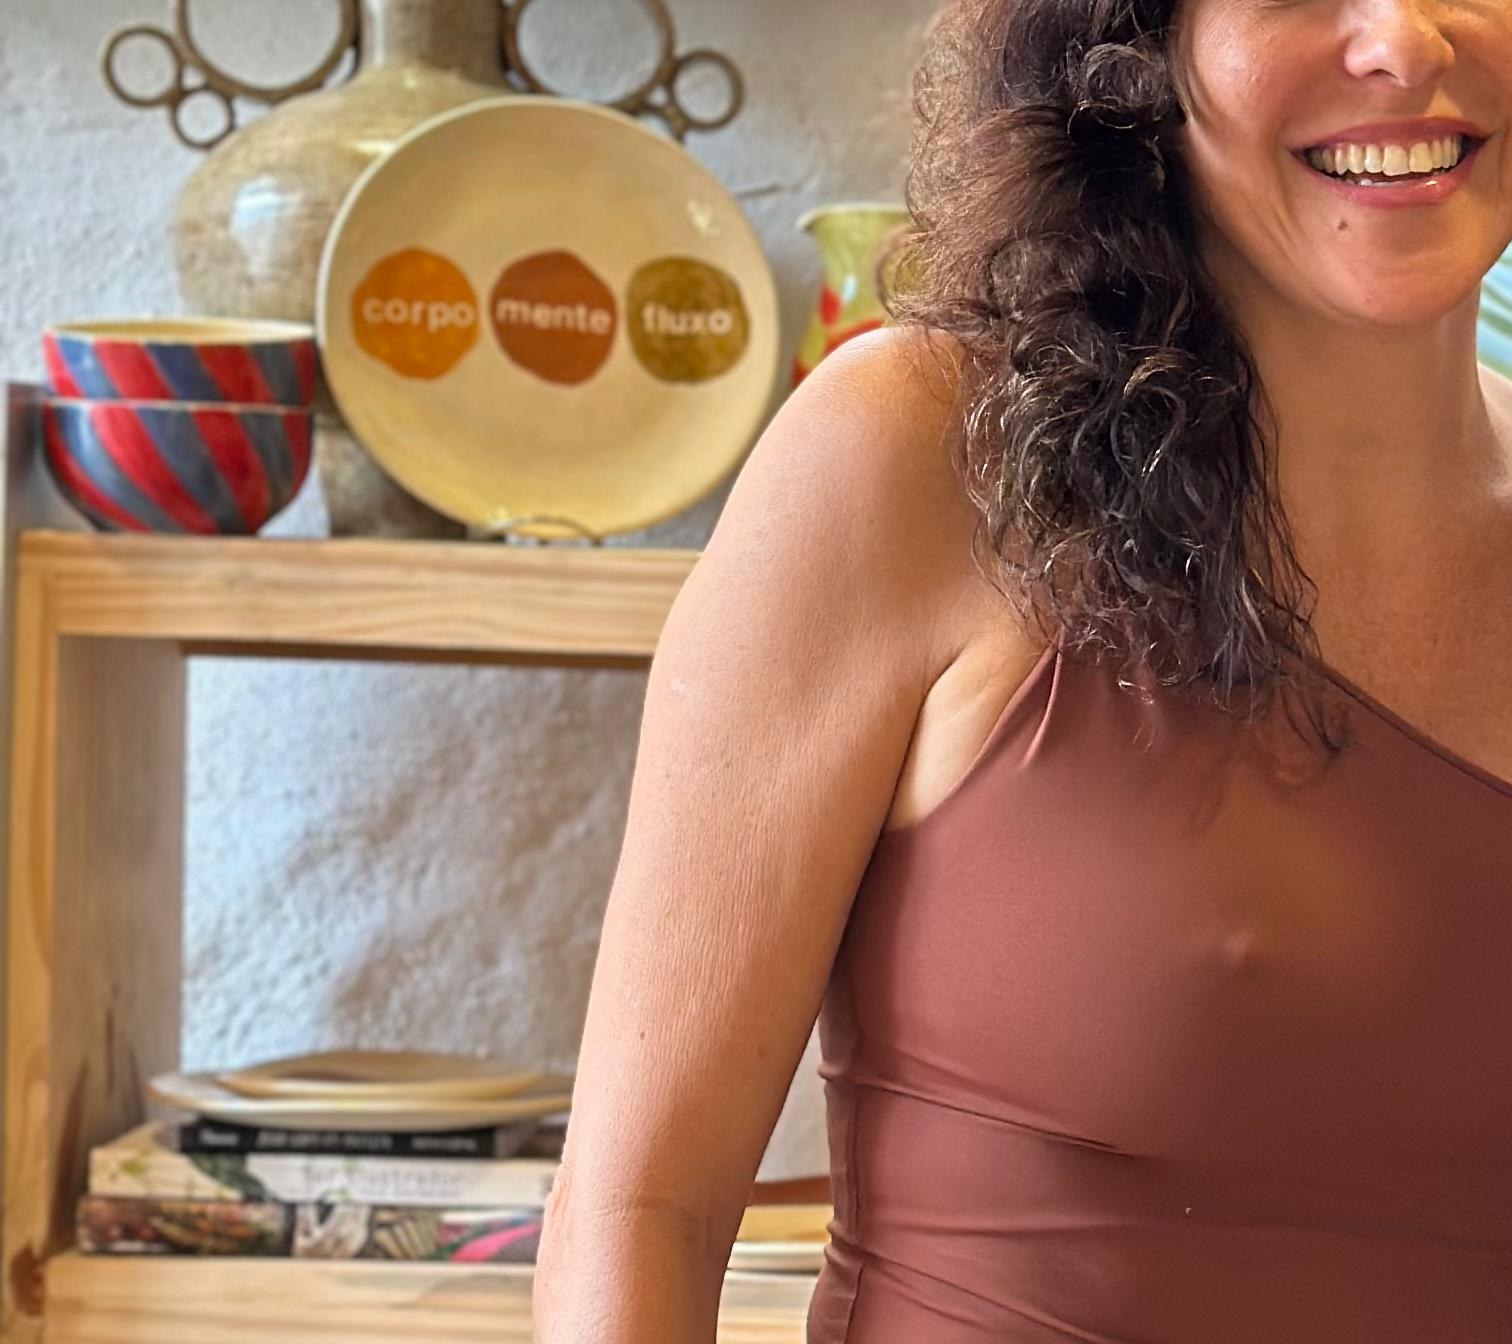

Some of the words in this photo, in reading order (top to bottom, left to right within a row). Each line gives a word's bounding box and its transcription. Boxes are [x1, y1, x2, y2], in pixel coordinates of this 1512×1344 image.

[362, 297, 474, 332] corpo
[496, 298, 612, 335] mente
[641, 302, 733, 337] fluxo
